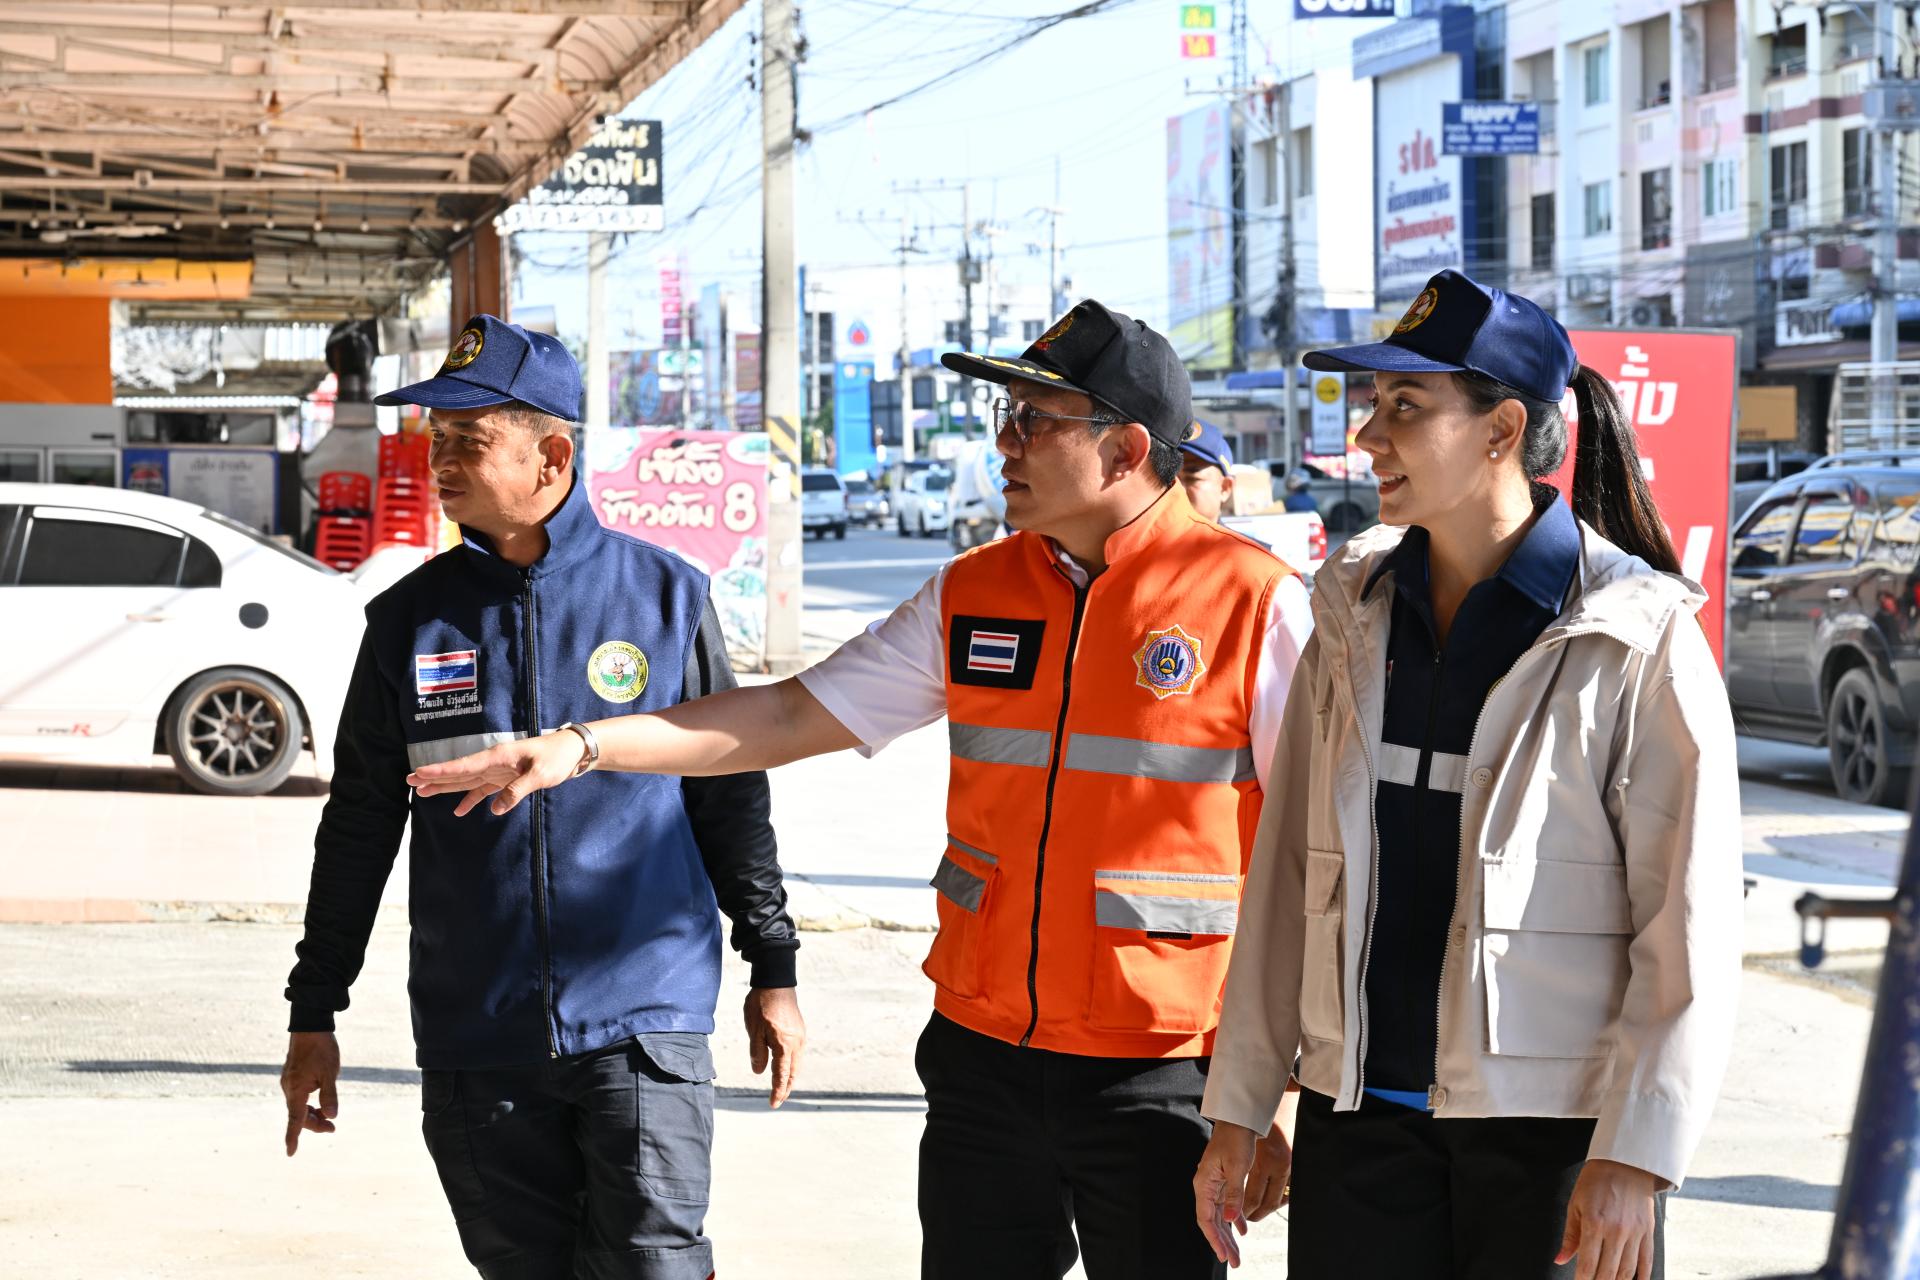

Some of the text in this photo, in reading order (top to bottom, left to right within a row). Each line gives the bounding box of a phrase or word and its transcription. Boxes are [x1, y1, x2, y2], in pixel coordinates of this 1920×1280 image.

[1461, 104, 1520, 123] HAPPY
[600, 481, 758, 533] ข้าวต้ม 8
[72, 723, 92, 737] R
